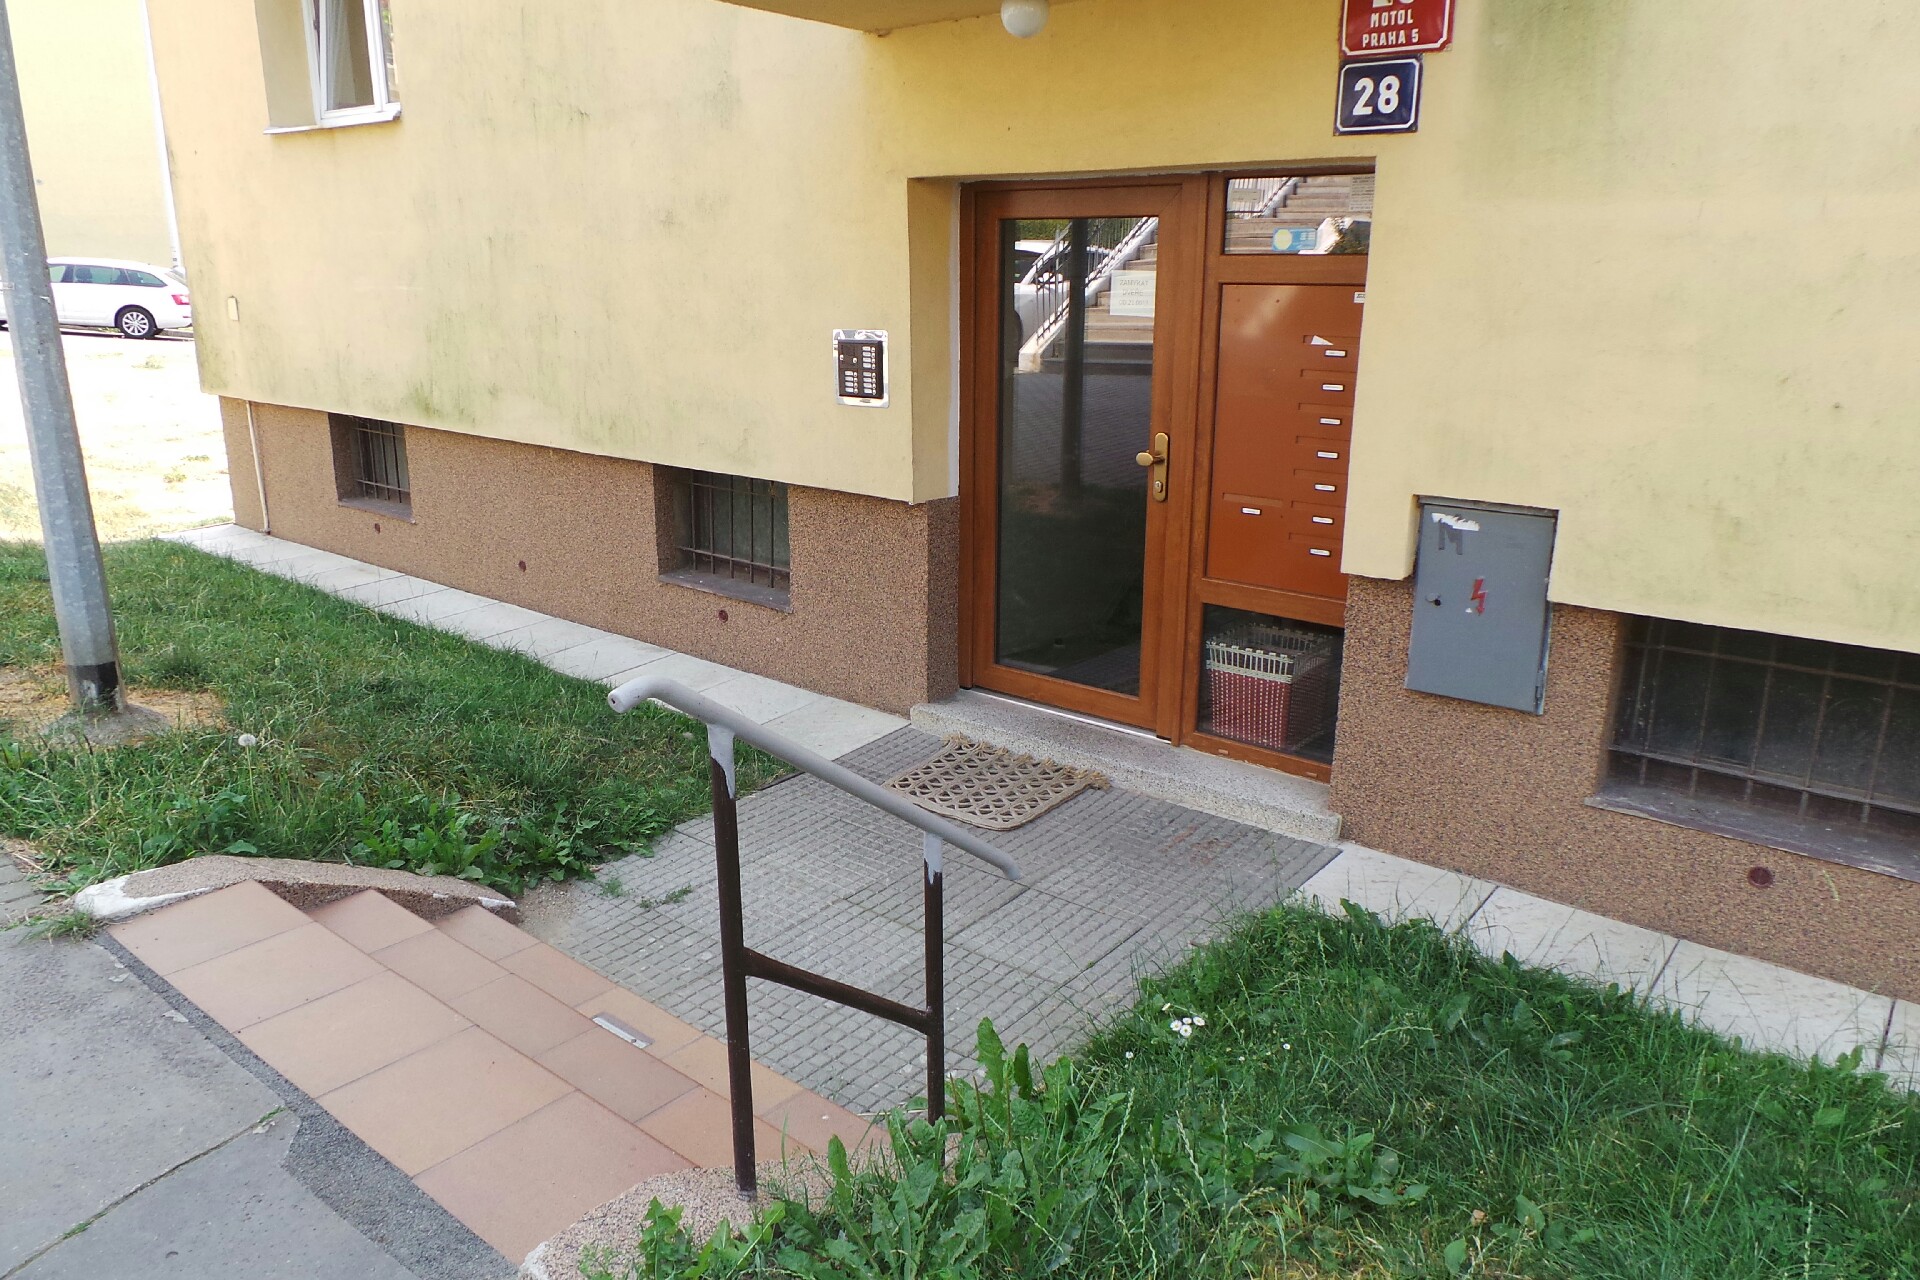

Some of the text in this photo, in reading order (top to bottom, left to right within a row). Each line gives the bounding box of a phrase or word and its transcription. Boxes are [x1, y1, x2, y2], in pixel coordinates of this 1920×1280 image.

[1370, 8, 1414, 28] MOTOL
[1362, 28, 1419, 48] PRAHA 5
[1352, 75, 1401, 116] 28
